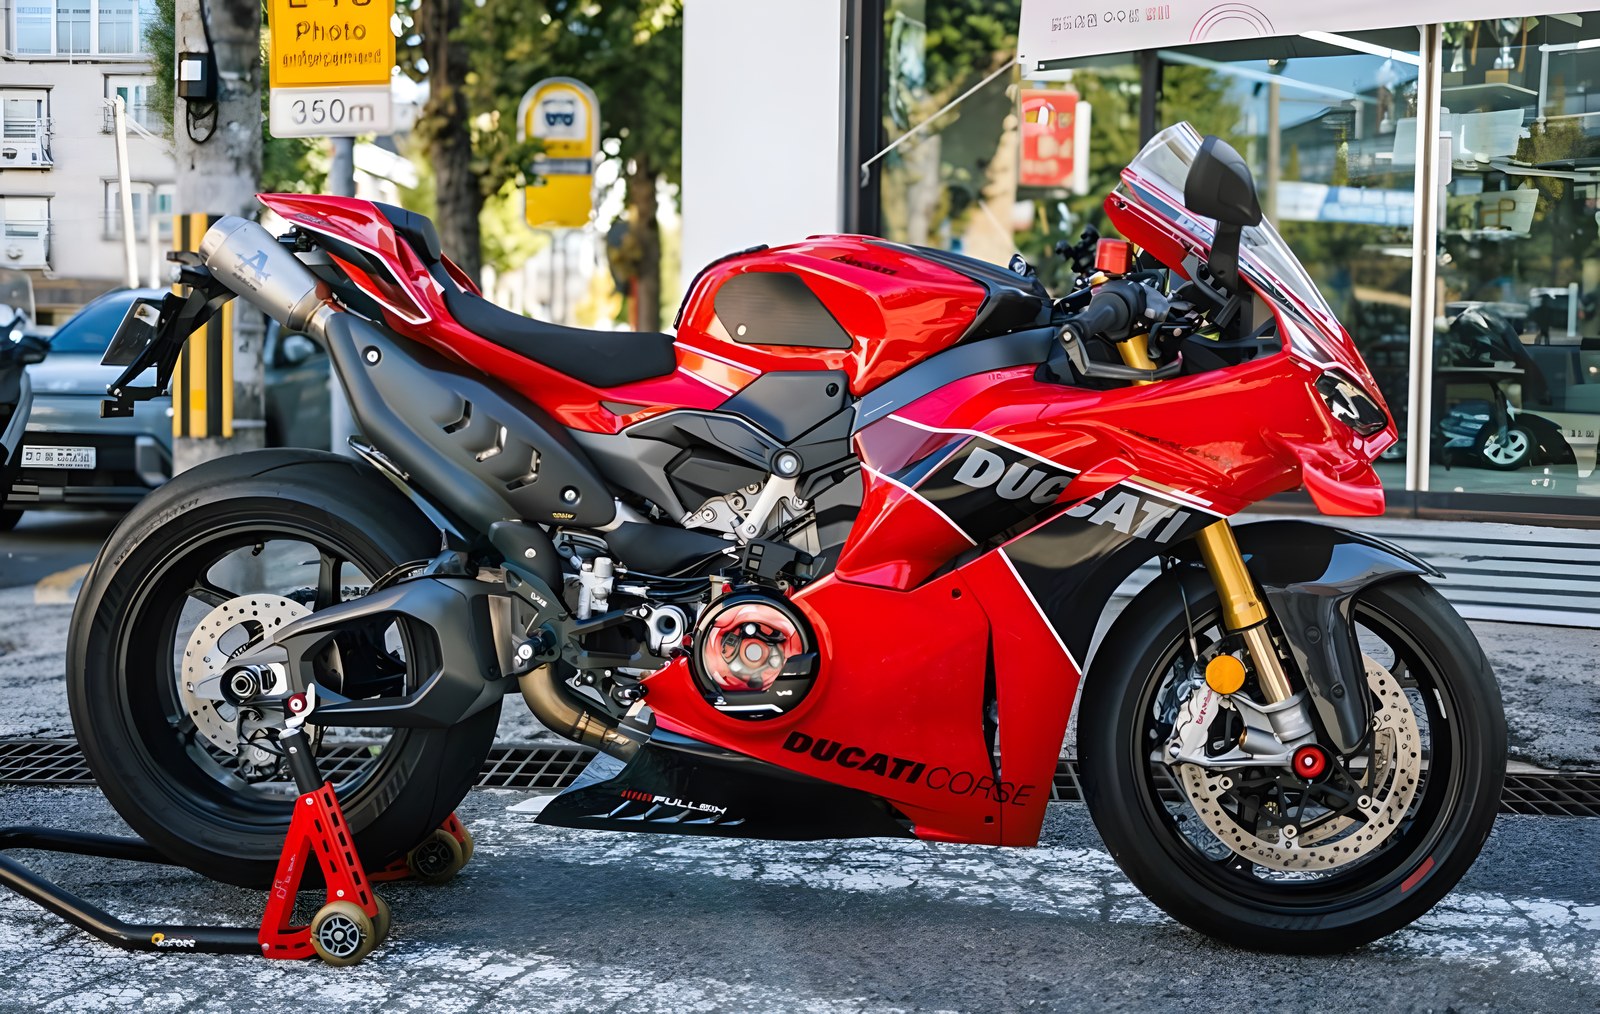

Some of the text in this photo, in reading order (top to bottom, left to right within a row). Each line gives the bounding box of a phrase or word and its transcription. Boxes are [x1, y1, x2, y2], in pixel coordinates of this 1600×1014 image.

[295, 20, 367, 42] Photo
[291, 98, 375, 125] 350m
[953, 446, 1191, 543] DUCATI
[782, 730, 1035, 806] DUCATI CORSE
